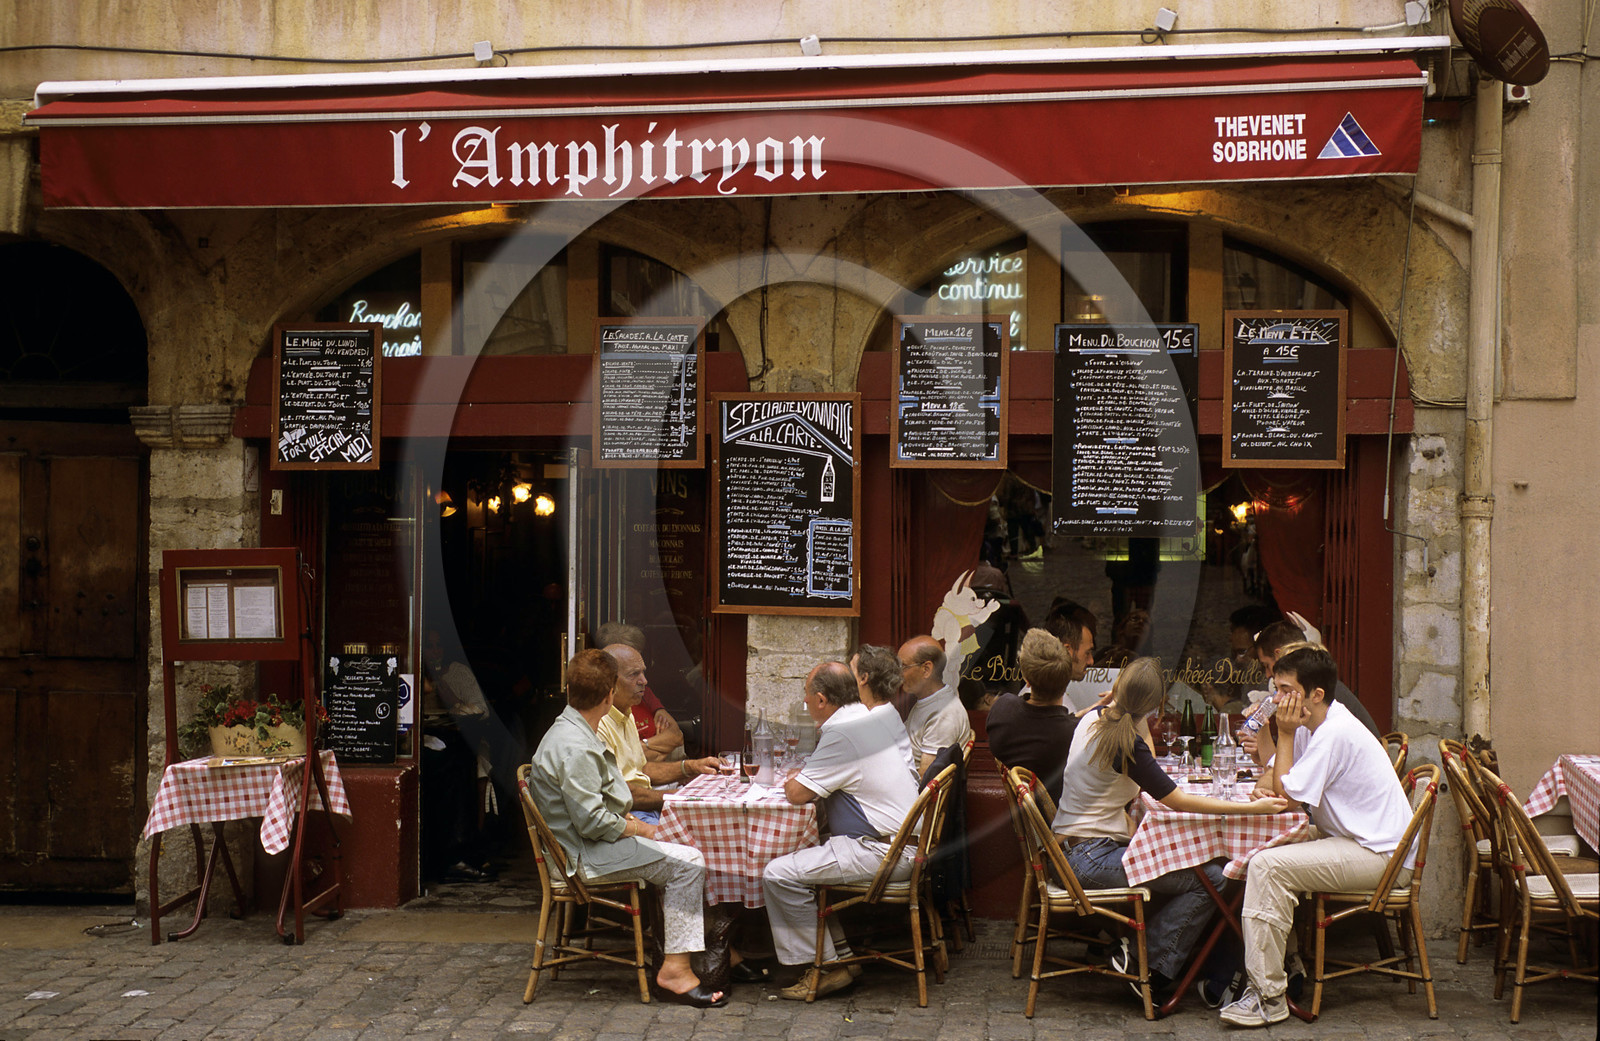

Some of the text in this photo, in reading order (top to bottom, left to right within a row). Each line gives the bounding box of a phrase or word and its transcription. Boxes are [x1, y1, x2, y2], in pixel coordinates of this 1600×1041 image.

[1214, 114, 1306, 137] THEVENET
[451, 121, 827, 197] Amphitryon
[1213, 139, 1307, 162] SOBRHONE
[943, 252, 1023, 276] service
[938, 278, 1024, 300] continu
[667, 333, 688, 342] CARTE
[1070, 330, 1193, 349] MENU DU BOUCHON 15€
[1263, 345, 1300, 357] A 15€
[776, 423, 816, 448] CARTE
[797, 401, 853, 450] LYONNAISE
[281, 430, 327, 461] FORMULE
[650, 470, 687, 498] VINS
[961, 655, 984, 680] Le
